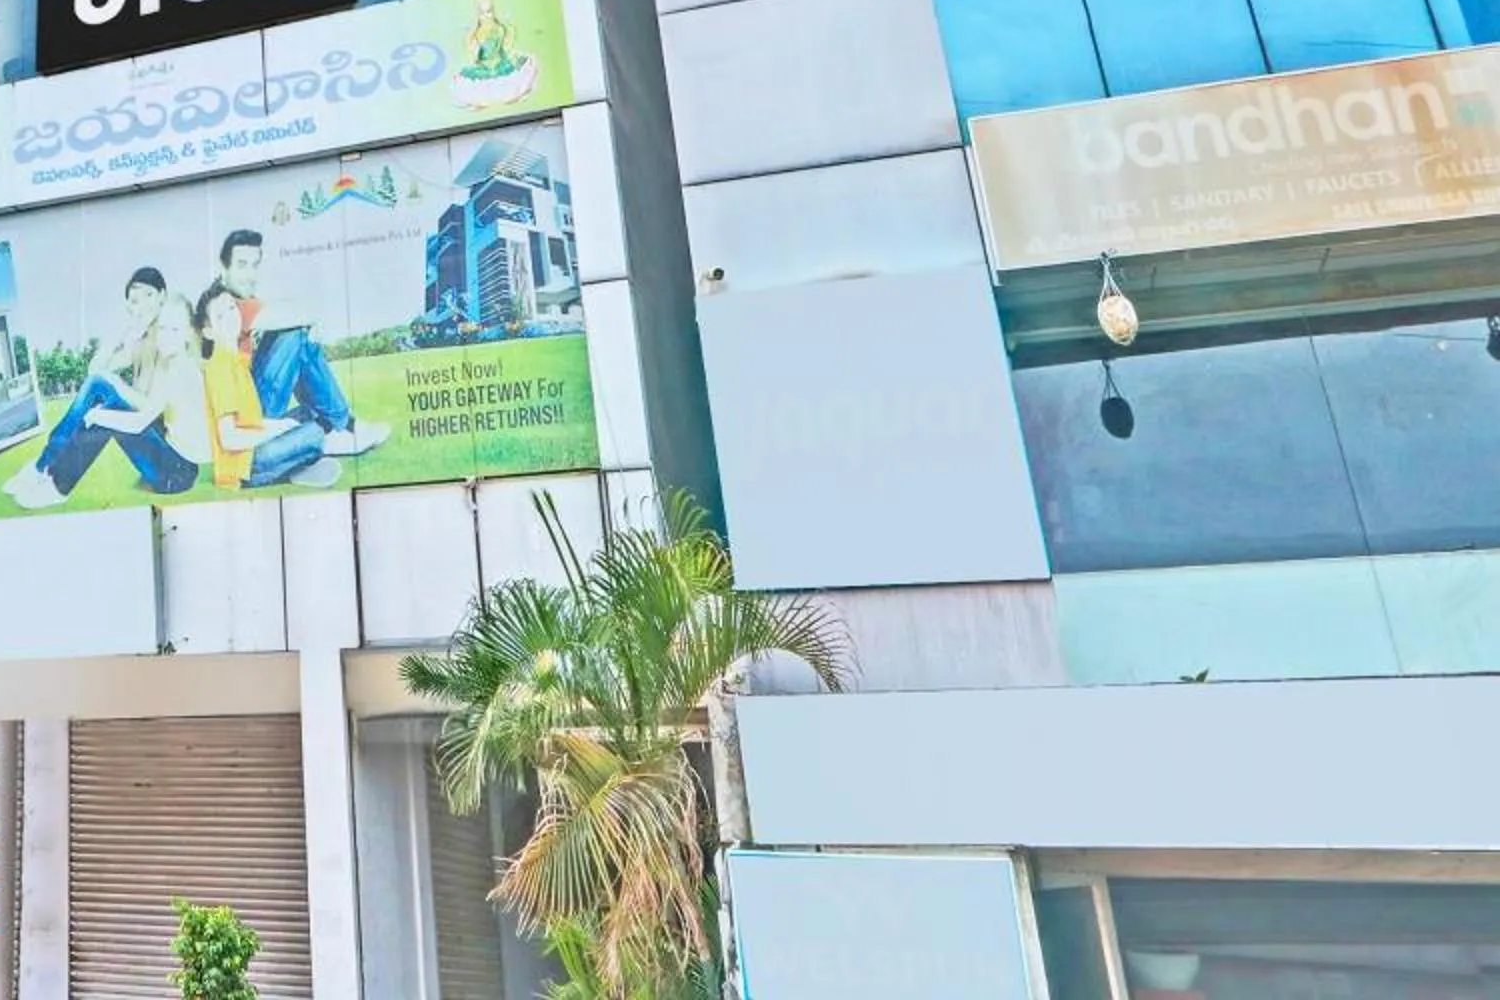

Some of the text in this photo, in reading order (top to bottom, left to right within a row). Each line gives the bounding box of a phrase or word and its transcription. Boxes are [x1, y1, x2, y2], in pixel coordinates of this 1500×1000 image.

[1070, 80, 1450, 175] bandhan
[1305, 168, 1401, 195] FAUCETS
[406, 357, 503, 387] Invest Now!
[407, 377, 565, 412] YOUR GATEWAY For
[409, 403, 565, 438] HIGHER RETURNS!!
